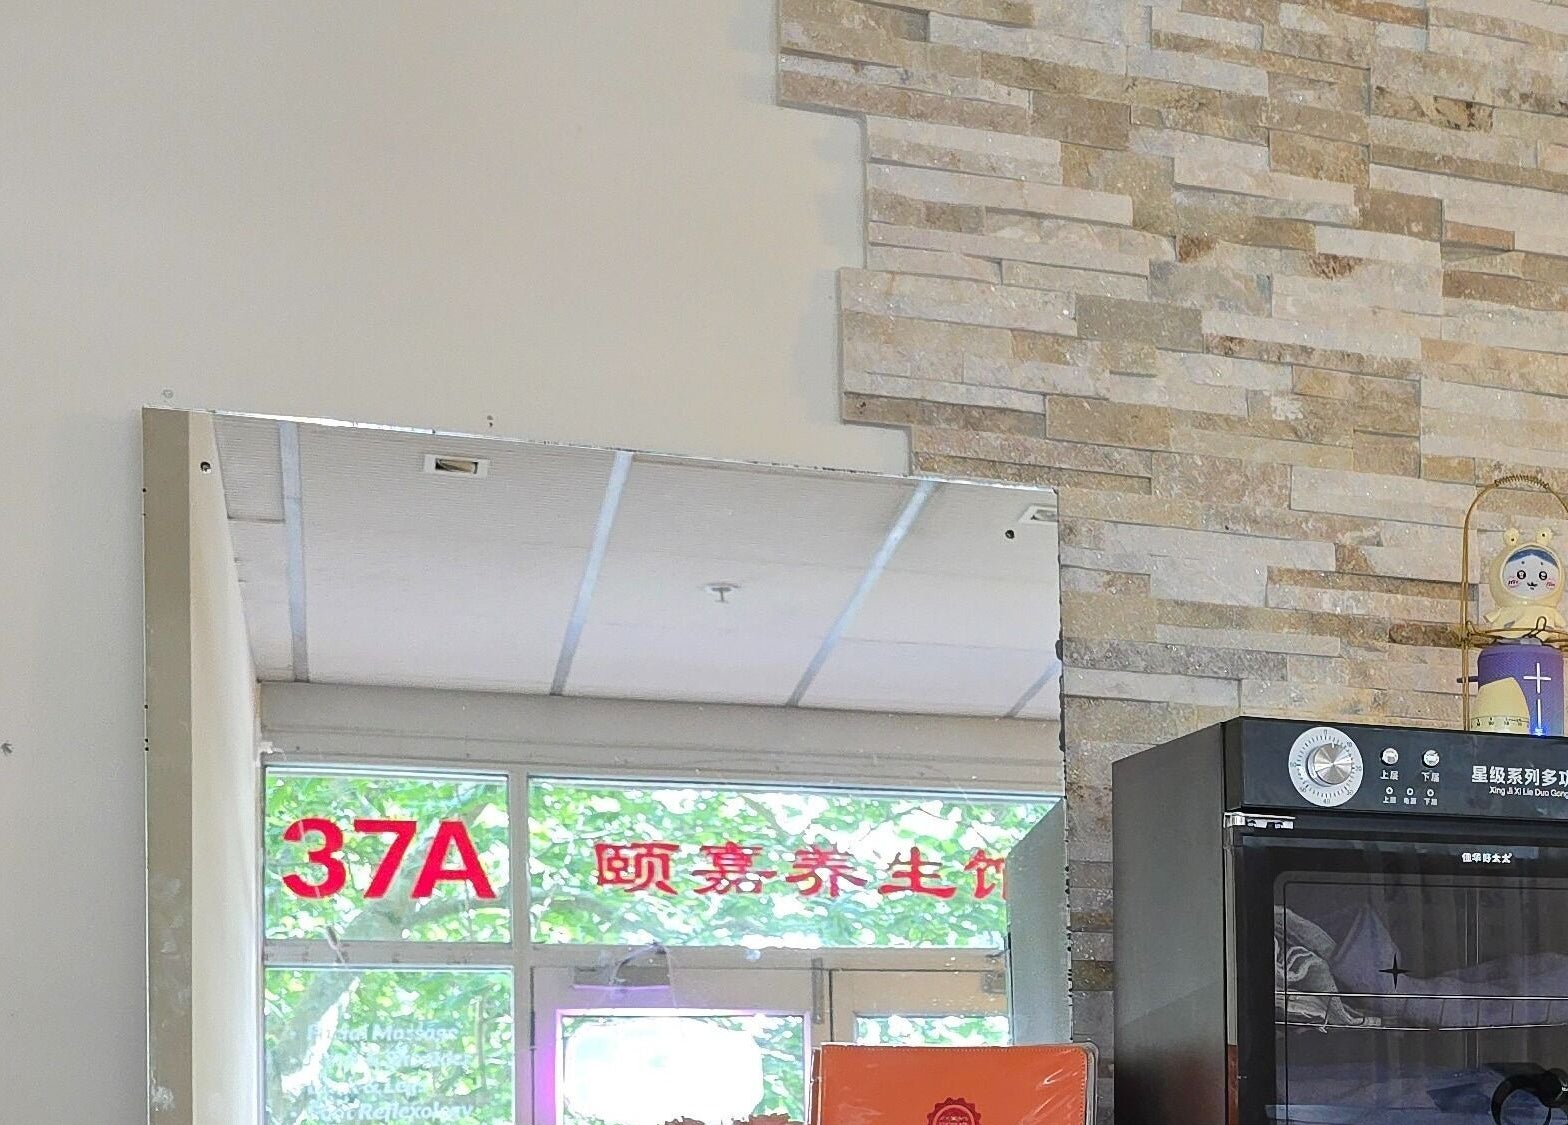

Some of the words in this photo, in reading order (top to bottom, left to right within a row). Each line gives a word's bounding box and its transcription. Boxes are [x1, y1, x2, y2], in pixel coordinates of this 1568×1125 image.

[1489, 786, 1506, 796] Xing
[1534, 788, 1550, 797] Duo
[281, 817, 497, 901] 37A
